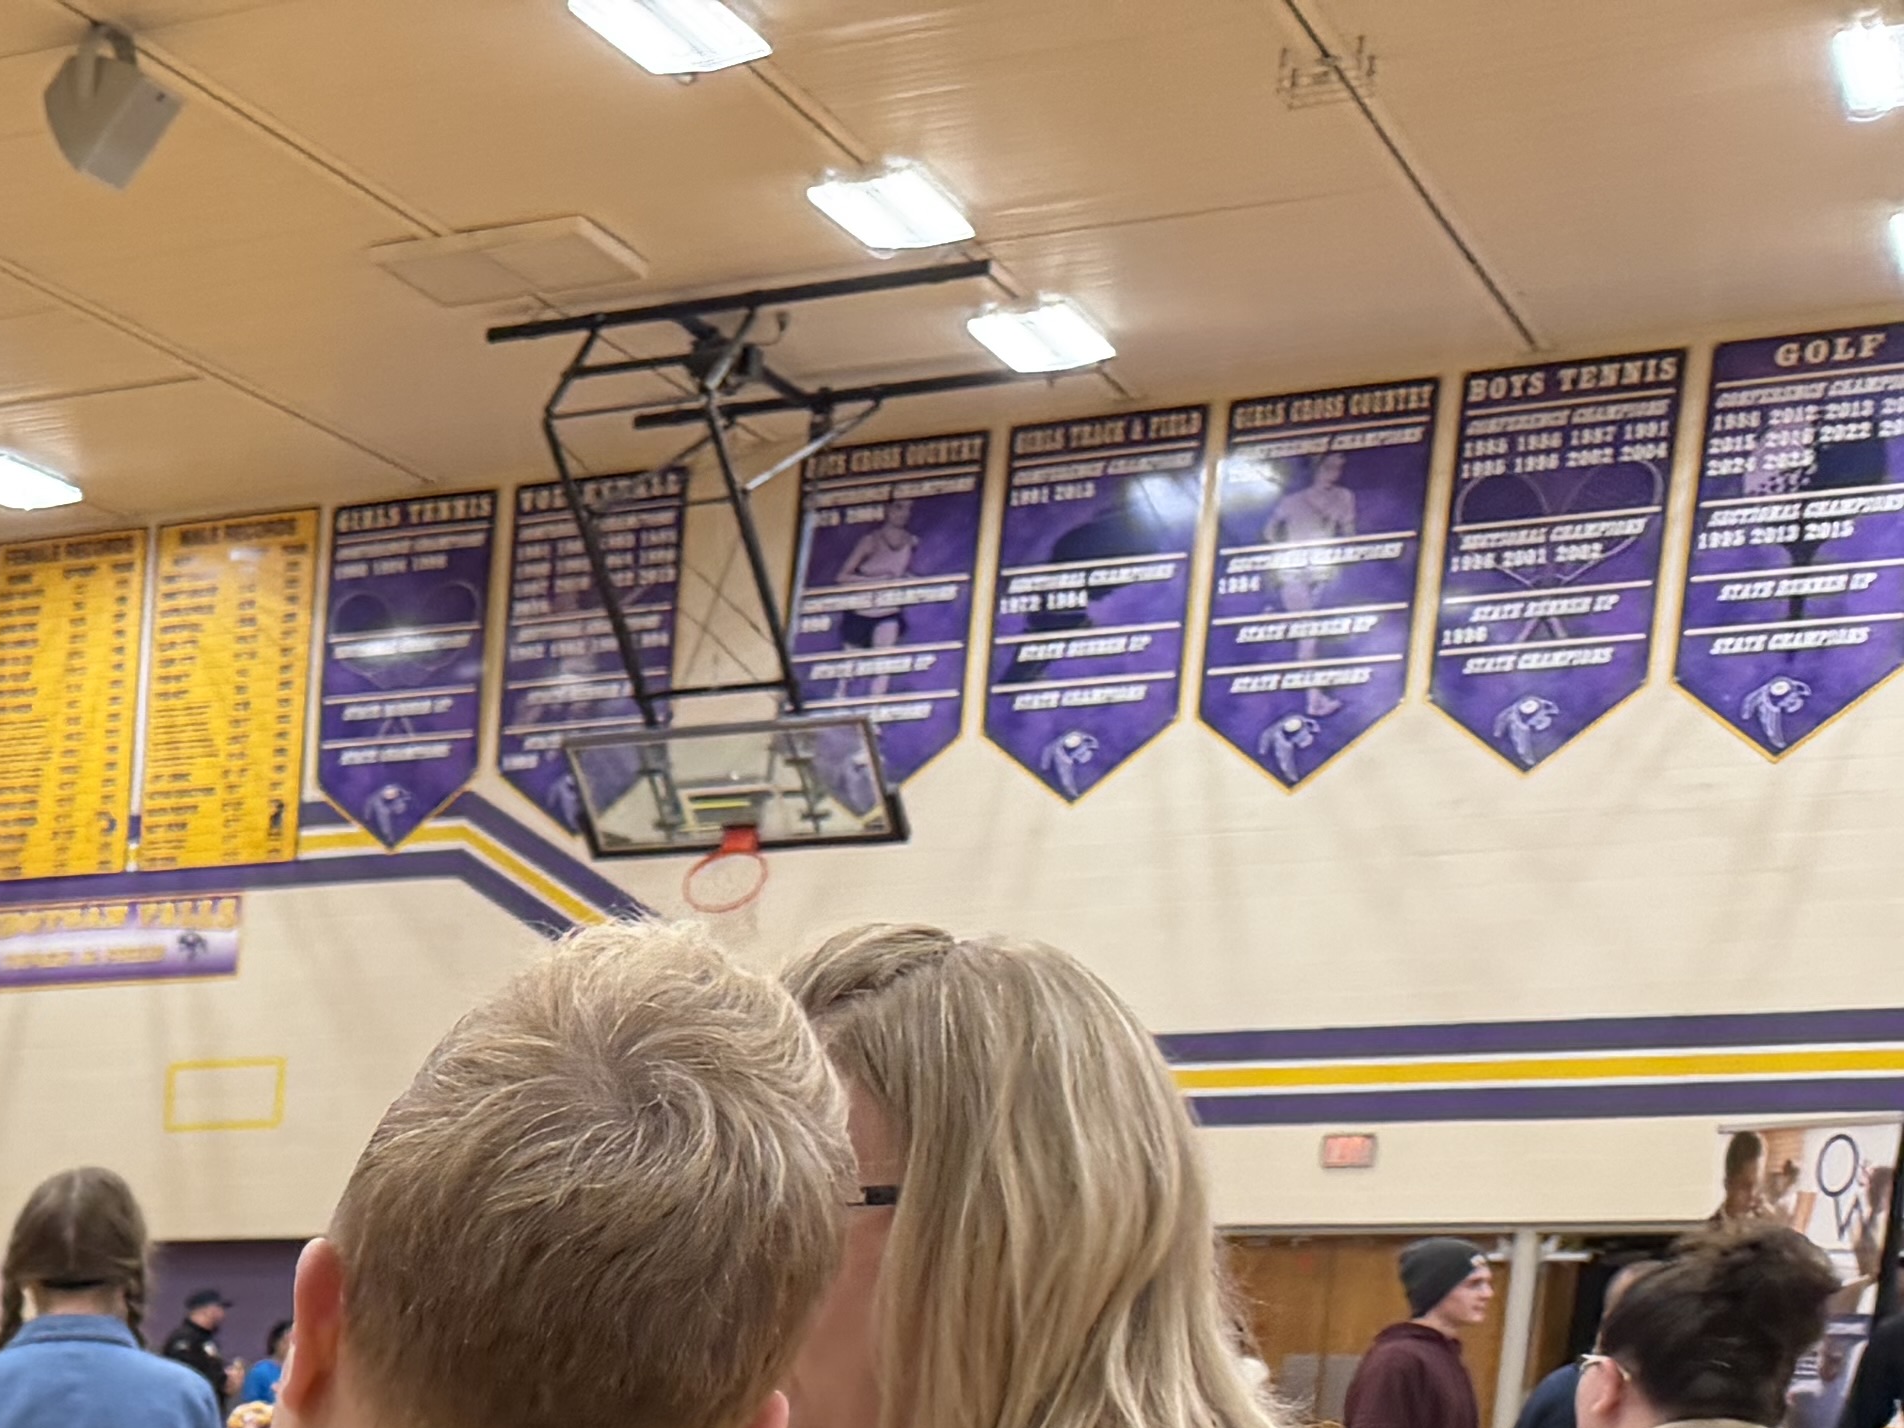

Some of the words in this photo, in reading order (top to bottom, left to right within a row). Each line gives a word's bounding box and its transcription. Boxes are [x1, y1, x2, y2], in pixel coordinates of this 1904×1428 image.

[1774, 333, 1887, 367] GOLF
[1467, 372, 1546, 402] BOYS
[1557, 357, 1677, 391] TENNIS
